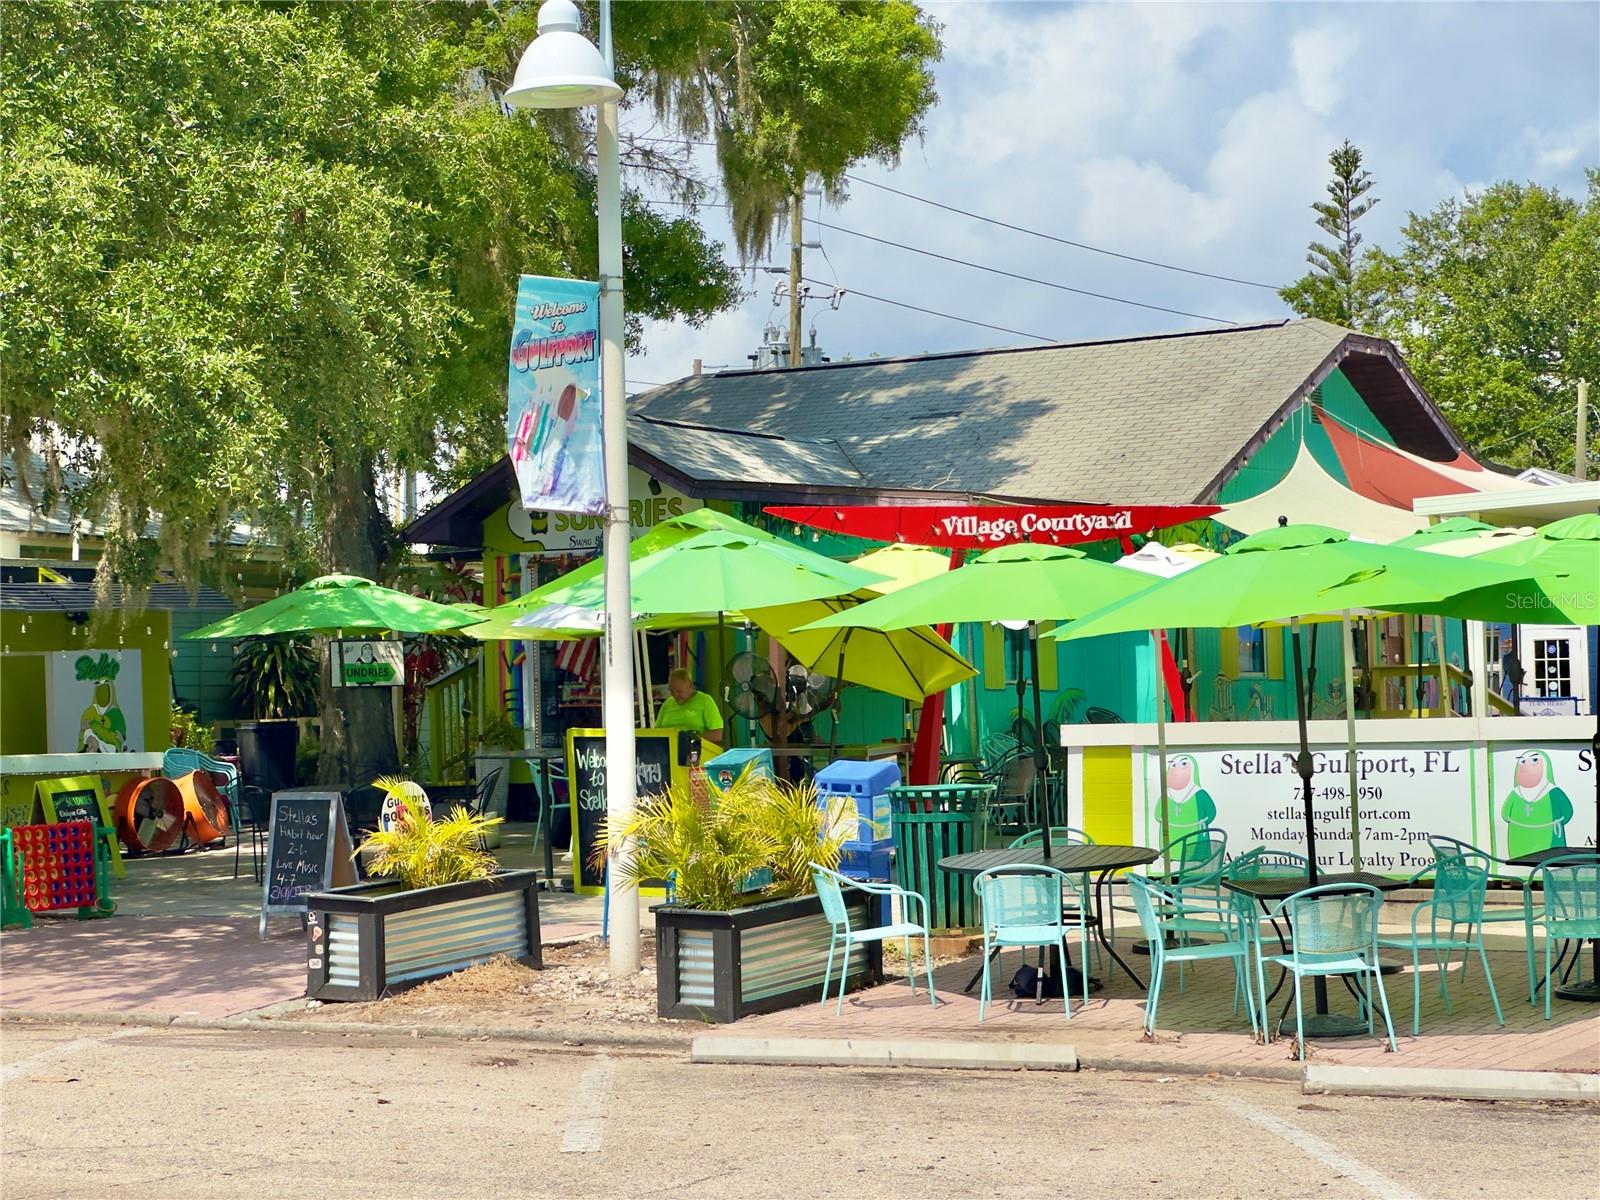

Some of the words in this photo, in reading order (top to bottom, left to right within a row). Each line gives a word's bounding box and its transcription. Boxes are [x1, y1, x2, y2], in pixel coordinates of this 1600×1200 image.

[531, 302, 587, 320] Welcome
[551, 319, 566, 333] To
[555, 497, 684, 532] SUNRIES
[942, 516, 1017, 541] Village
[1021, 511, 1132, 535] Courtyard
[345, 667, 390, 679] UNDRIES
[1424, 751, 1460, 773] FL
[1365, 827, 1430, 845] 7am-2pm
